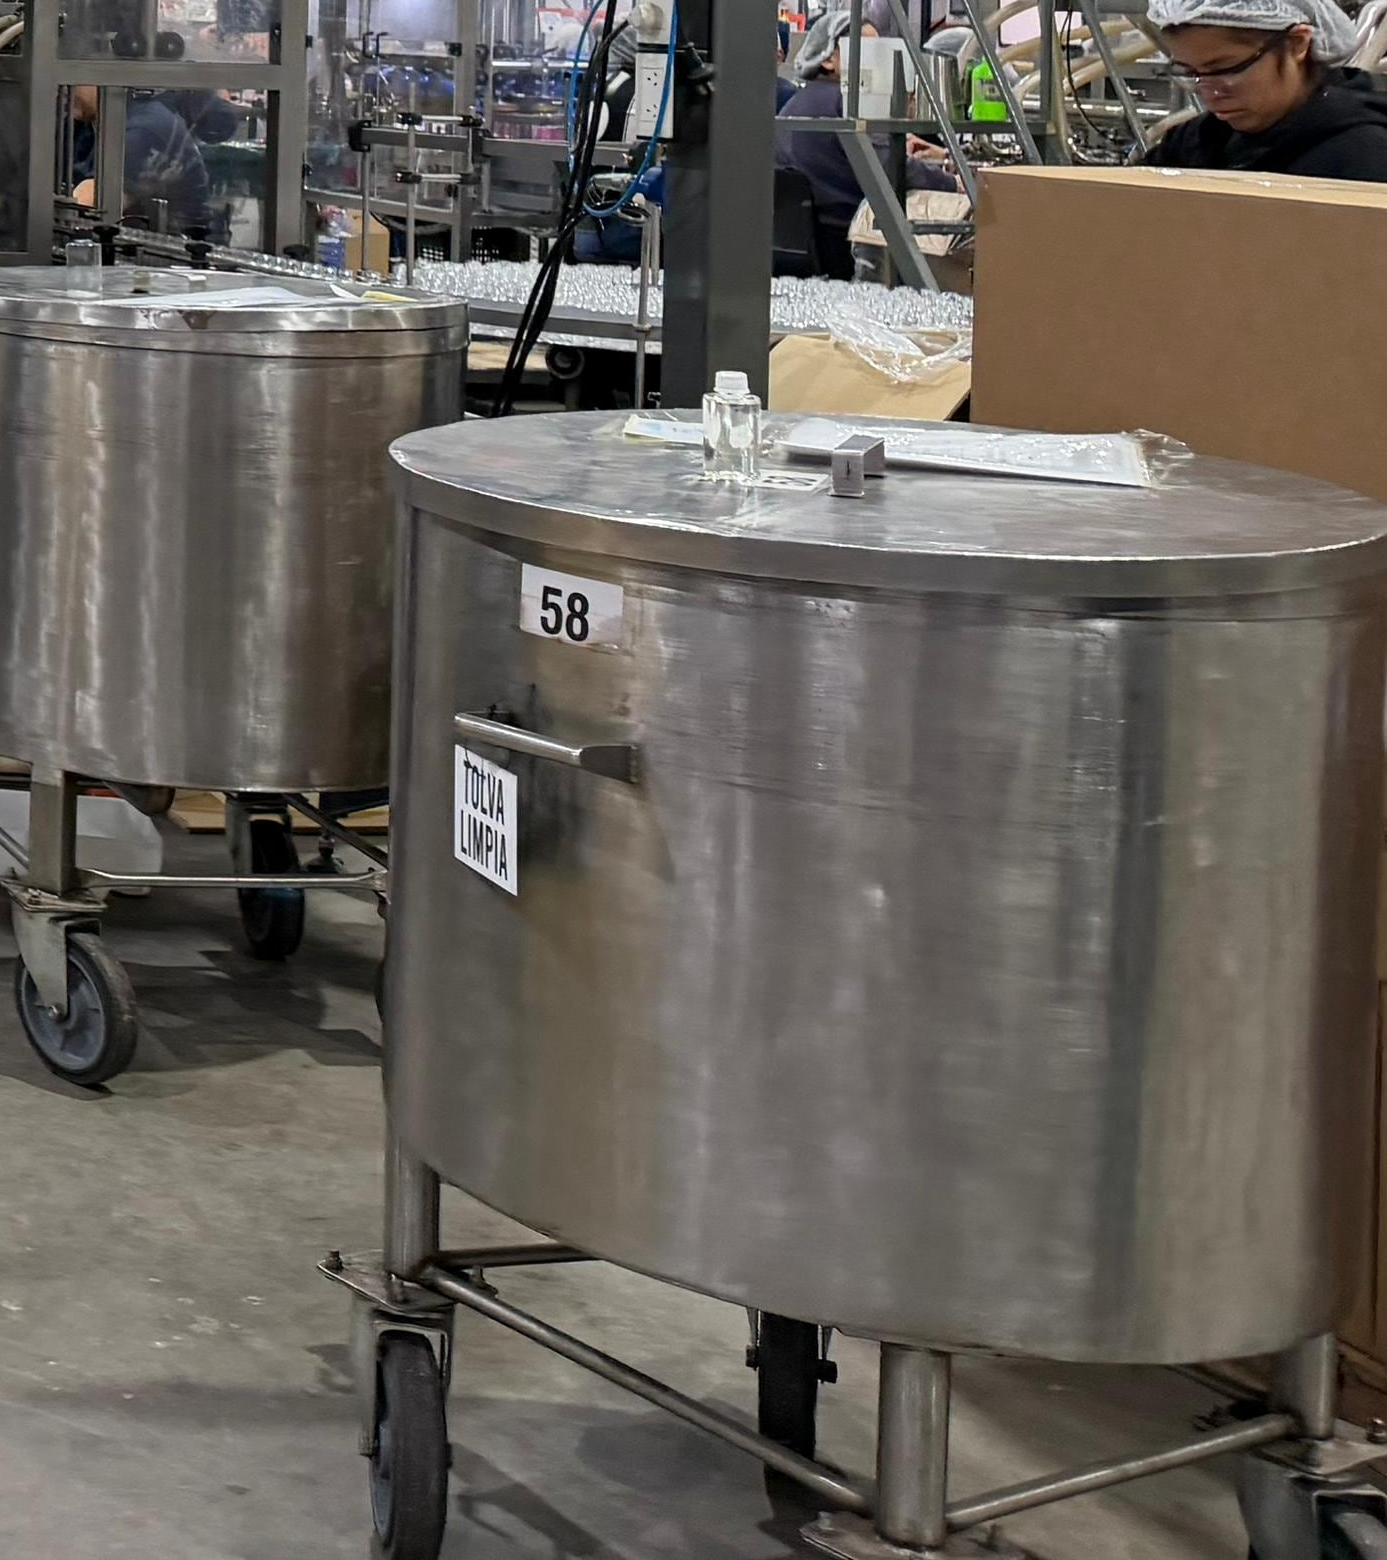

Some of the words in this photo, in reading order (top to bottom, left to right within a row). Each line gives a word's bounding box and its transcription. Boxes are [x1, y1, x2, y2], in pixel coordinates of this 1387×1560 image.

[540, 584, 590, 642] 58
[463, 760, 506, 827] TOLVA
[460, 809, 509, 882] LIMPIA
